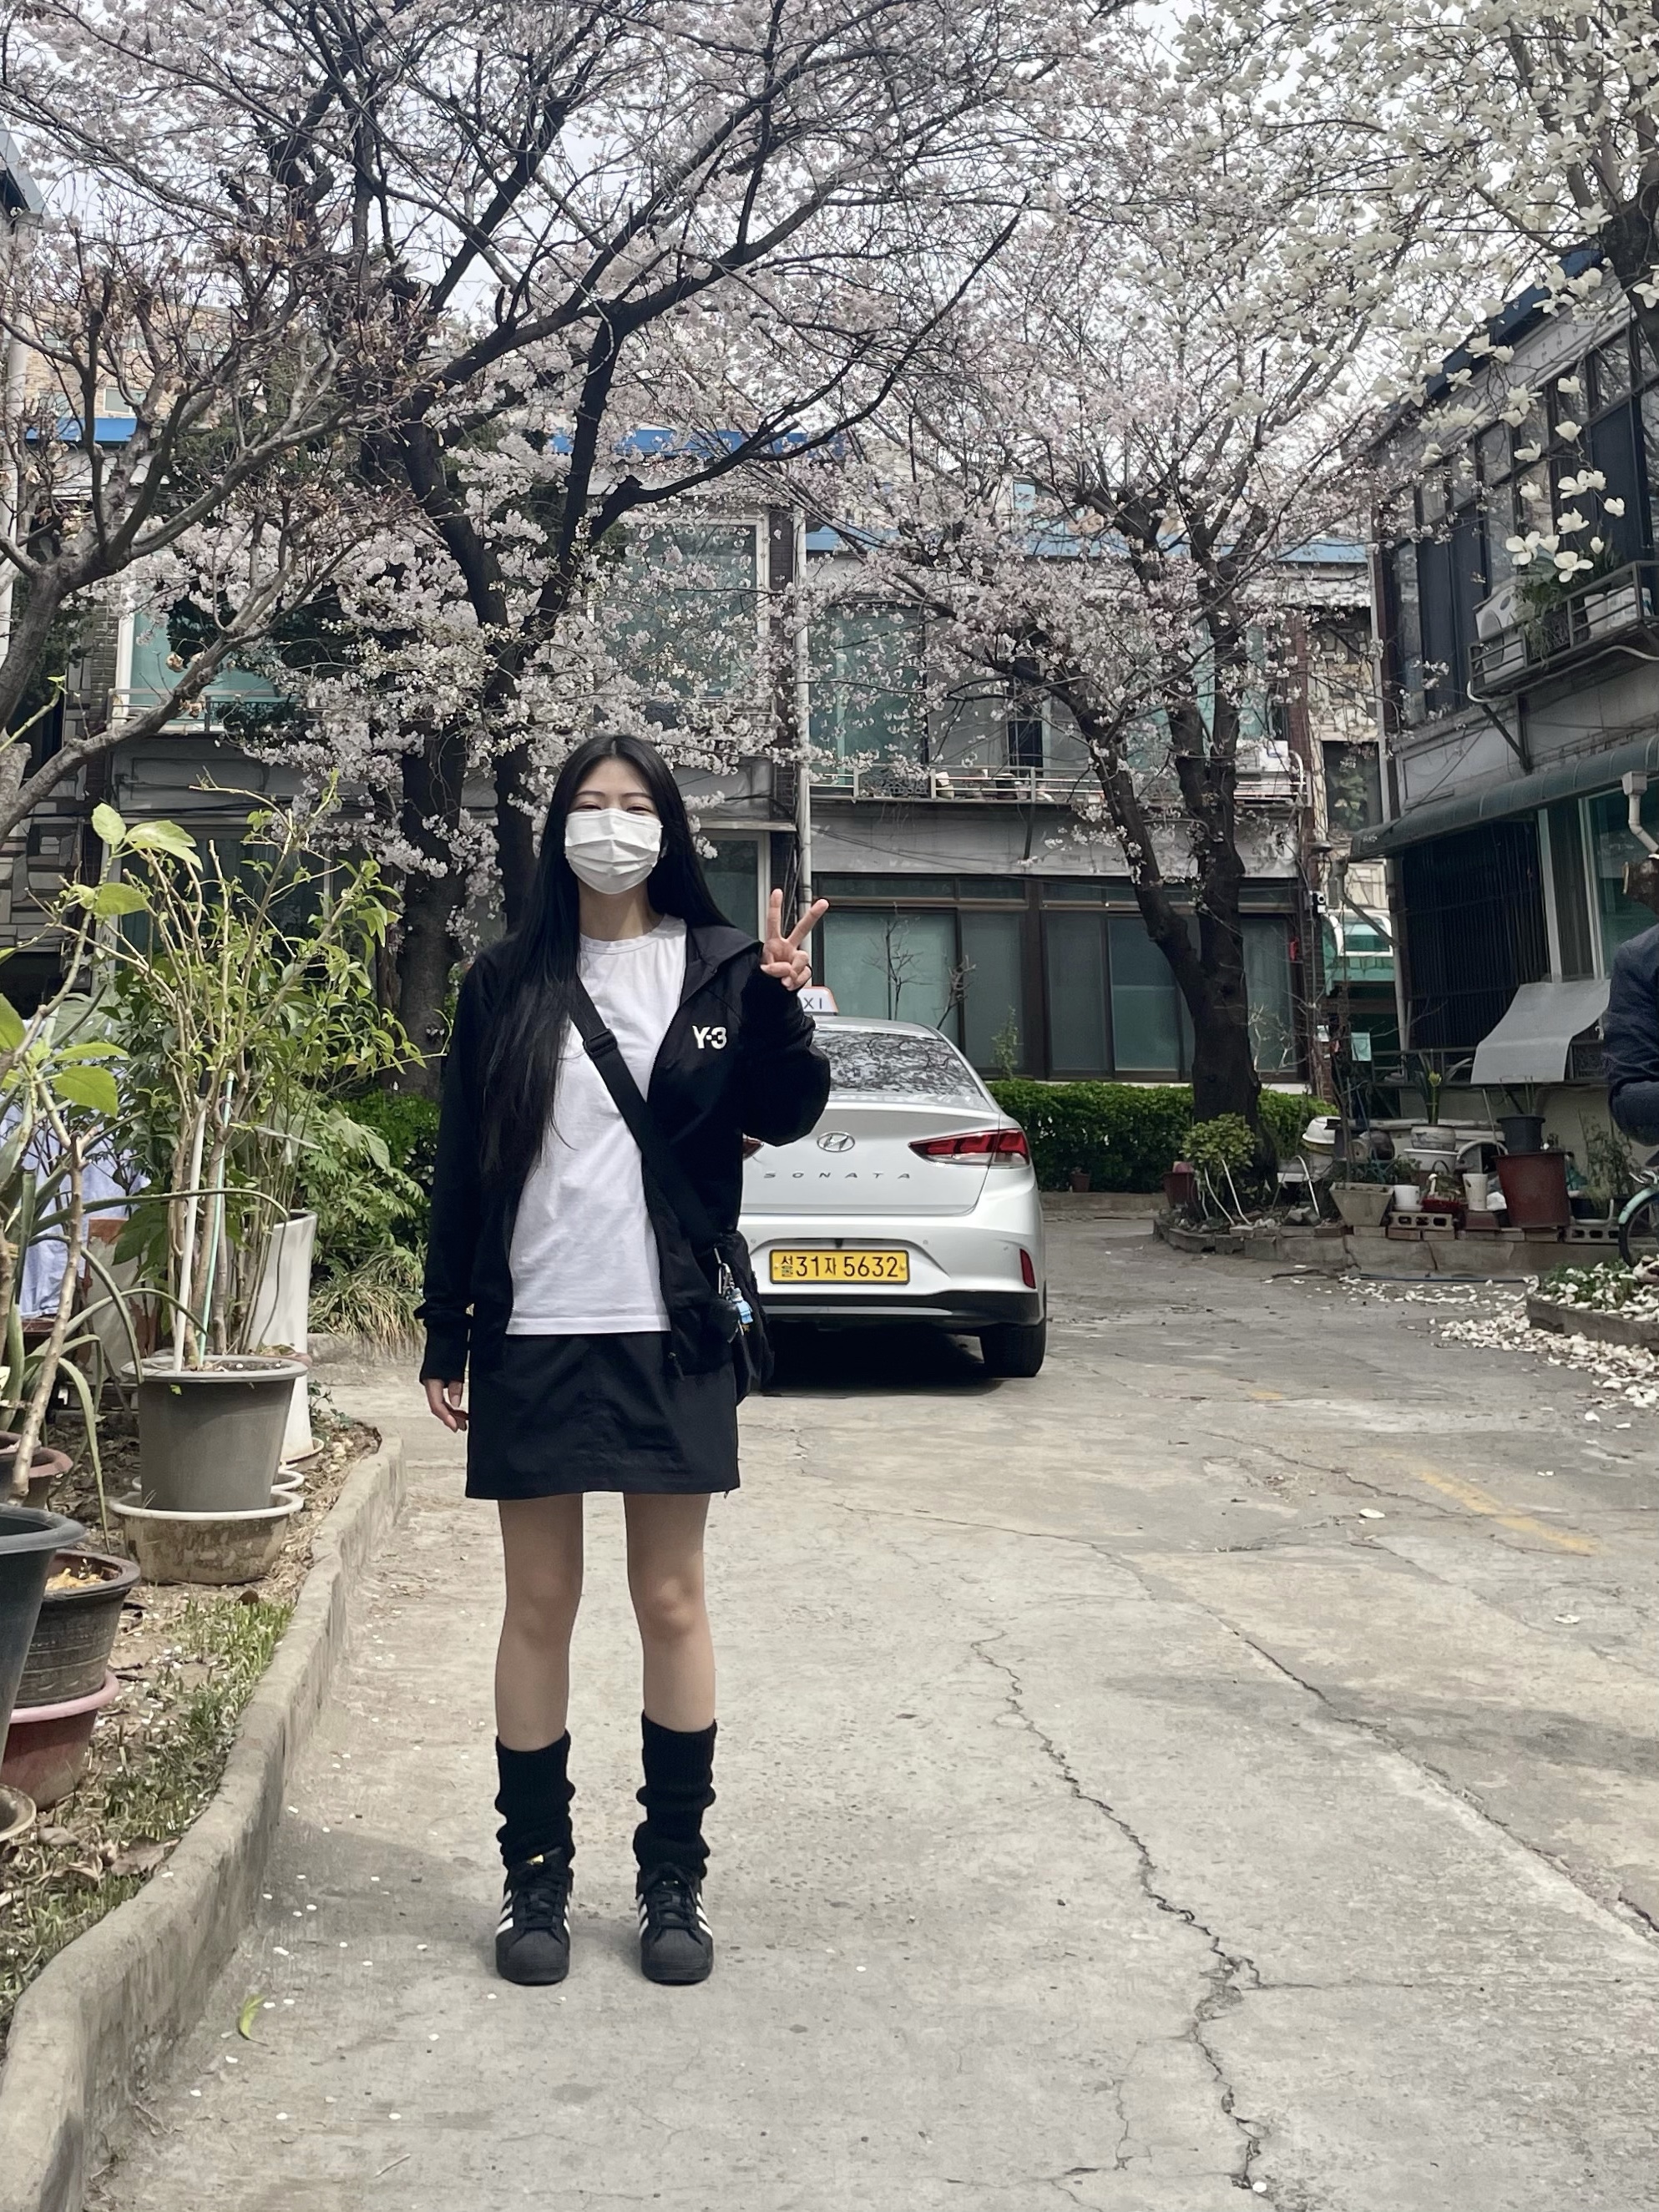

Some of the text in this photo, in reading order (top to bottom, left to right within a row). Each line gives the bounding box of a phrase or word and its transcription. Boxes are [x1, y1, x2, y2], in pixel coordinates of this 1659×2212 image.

[803, 997, 822, 1010] XI
[692, 1025, 727, 1050] Y-3
[843, 1256, 899, 1277] 5632
